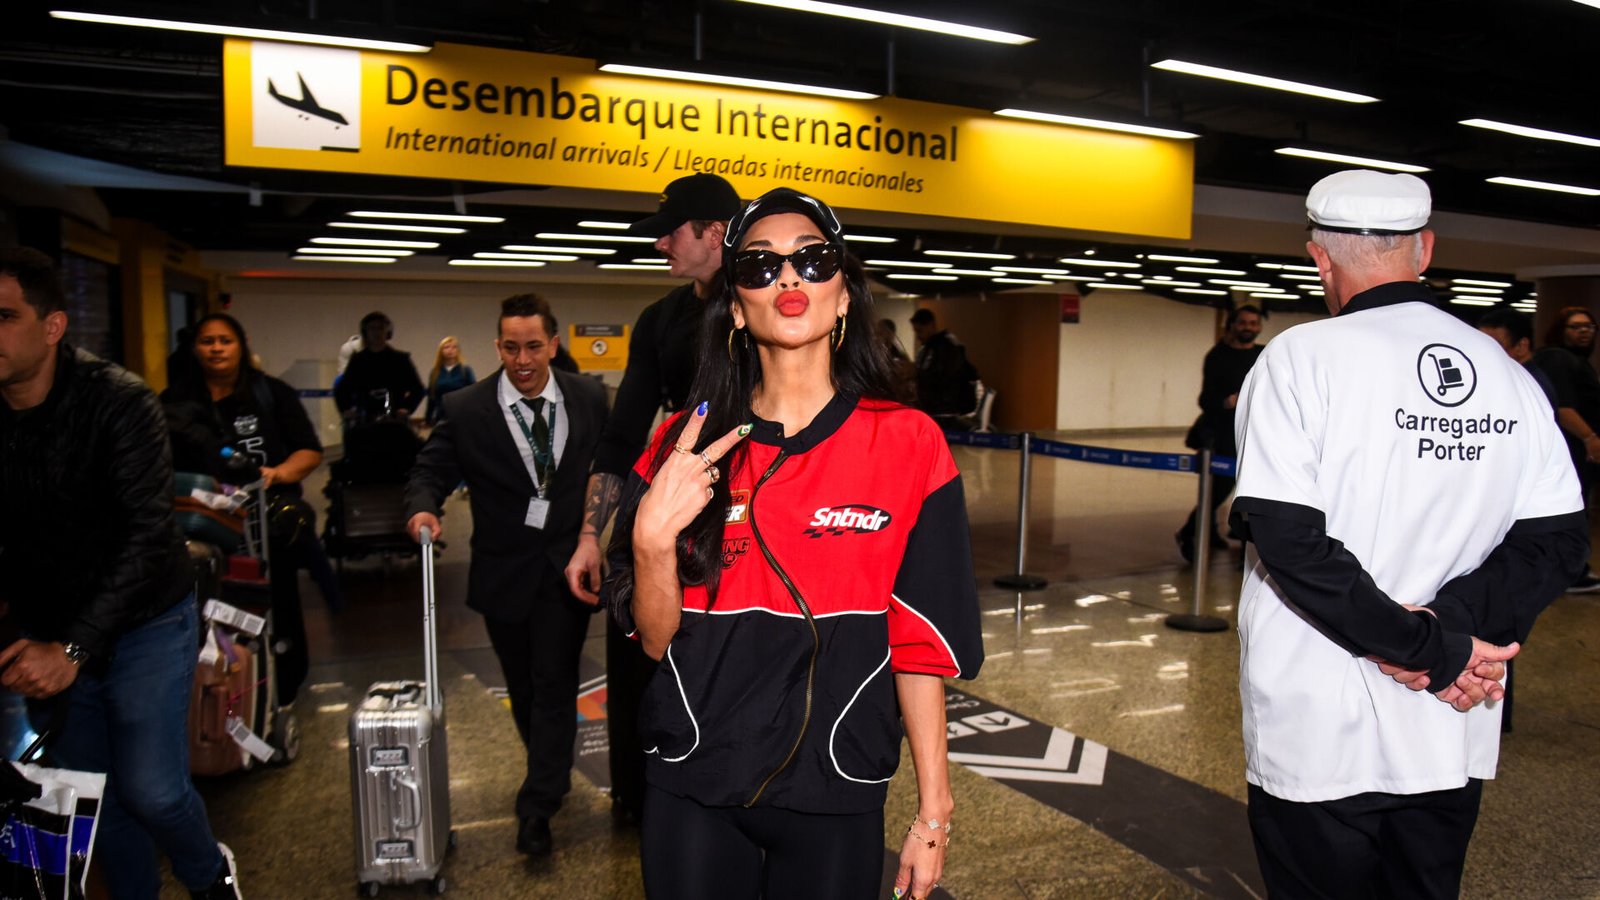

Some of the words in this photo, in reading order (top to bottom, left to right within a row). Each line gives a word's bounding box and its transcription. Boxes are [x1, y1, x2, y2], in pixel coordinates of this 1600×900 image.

[386, 64, 700, 140] Desembarque
[716, 98, 957, 162] Internacional
[385, 126, 557, 160] International
[562, 142, 649, 168] arrivals
[653, 146, 670, 173] /
[674, 149, 767, 178] Llegadas
[773, 158, 924, 193] internacionales
[1395, 408, 1518, 439] Carregador
[1418, 438, 1485, 461] Porter
[809, 507, 889, 531] Sntndr
